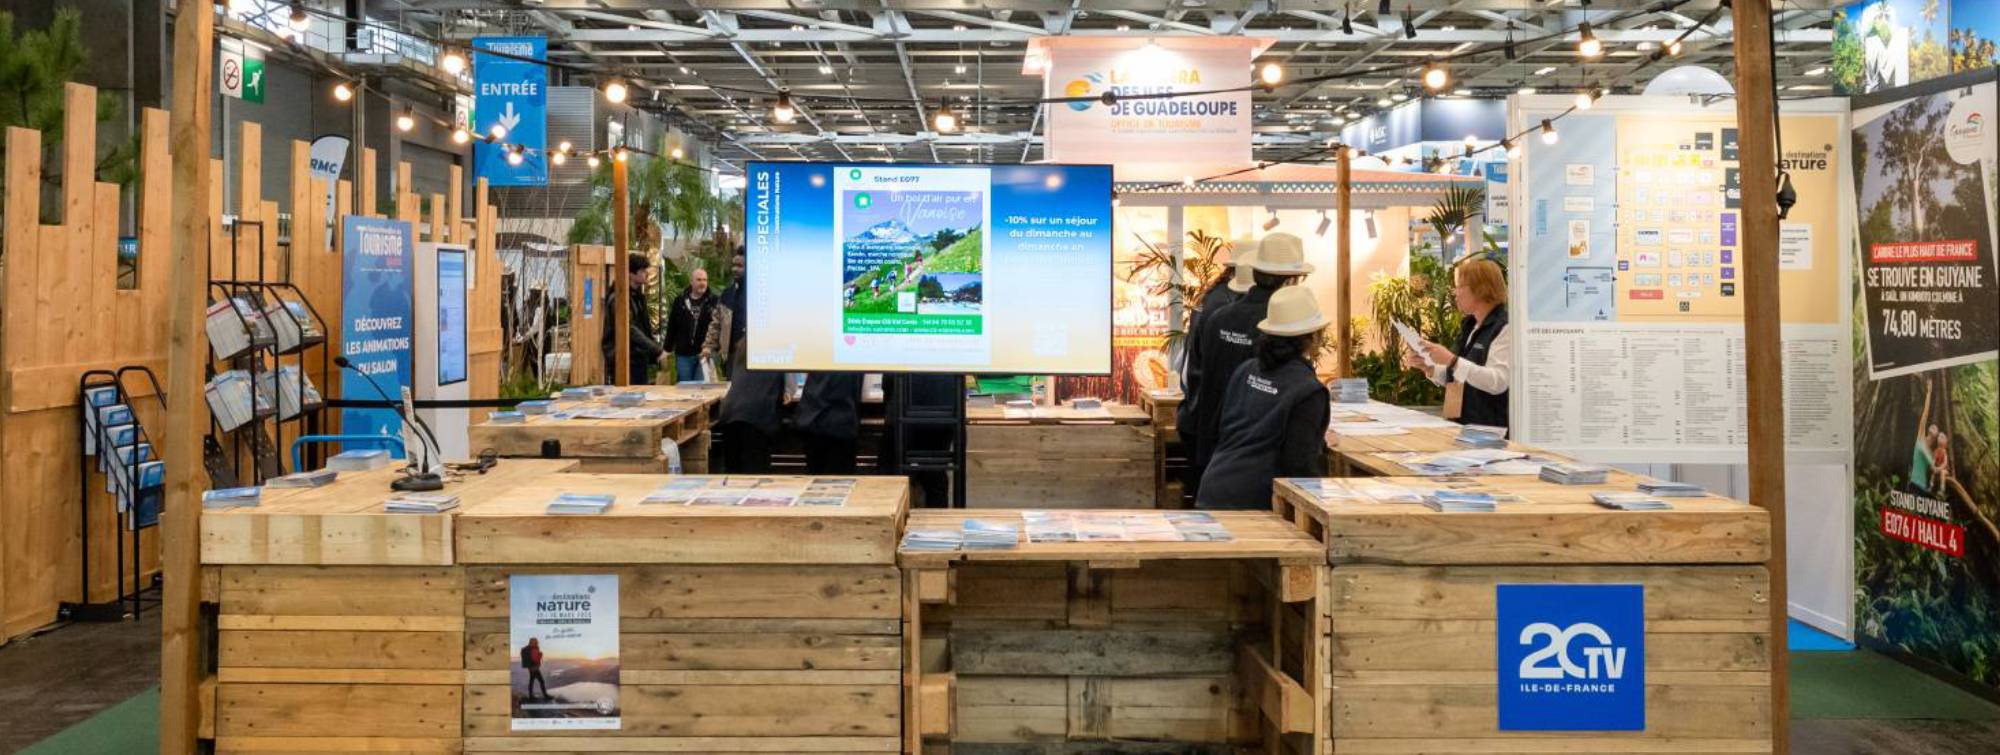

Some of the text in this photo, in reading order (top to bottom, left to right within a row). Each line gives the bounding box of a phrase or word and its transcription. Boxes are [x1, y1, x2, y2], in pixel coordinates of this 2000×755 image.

[481, 79, 537, 96] ENTRÉE
[1110, 101, 1237, 115] DE GUADELOUPE
[310, 158, 337, 174] RMC
[874, 175, 897, 183] Stand
[1004, 215, 1098, 227] -10% sur un séjour
[1009, 229, 1023, 238] du
[1025, 229, 1077, 238] dimanche
[1936, 244, 1945, 257] DE
[1946, 243, 1973, 257] FRANCE
[1867, 265, 1983, 288] SE TROUVE EN GUYANE
[355, 315, 402, 331] DÉCOUVREZ
[1882, 309, 1961, 340] 74,80 MÈTRES
[346, 337, 409, 355] LES ANIMATIONS
[371, 360, 397, 374] SALON
[1890, 489, 1950, 520] STAND GUYANE
[1885, 512, 1958, 552] E076 / HALL 4
[1520, 684, 1615, 693] ILE-DE-FRANCE
